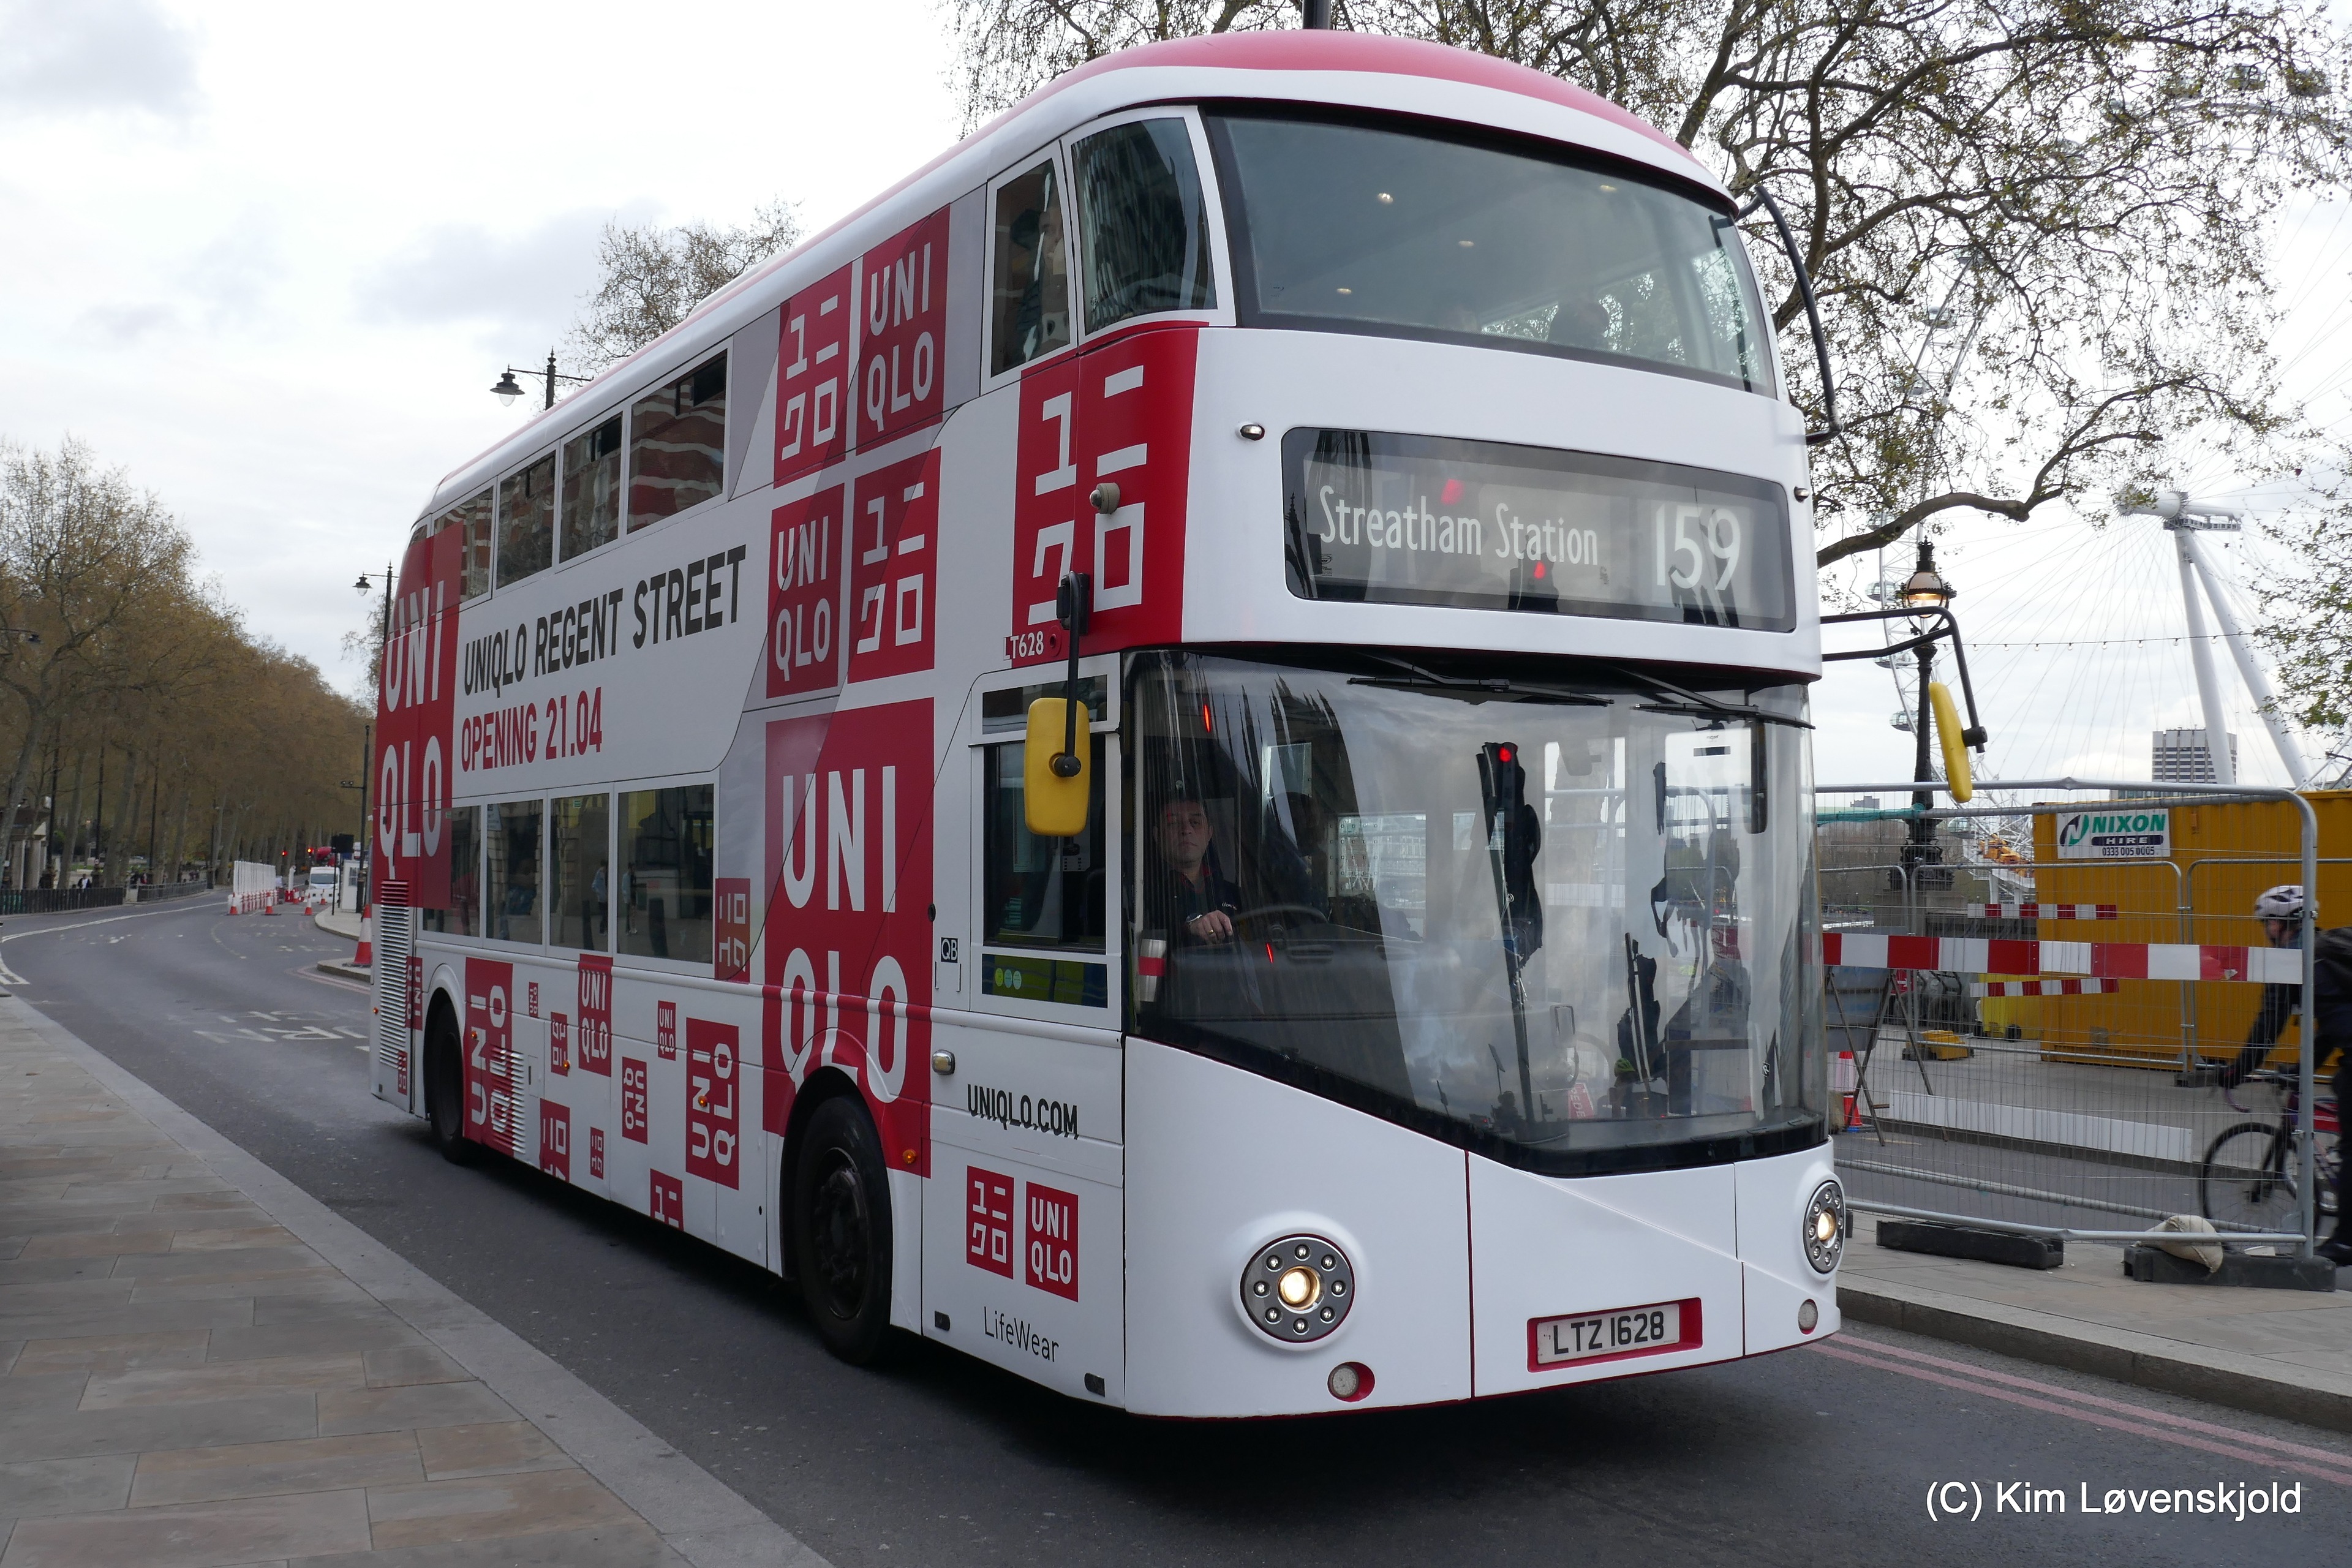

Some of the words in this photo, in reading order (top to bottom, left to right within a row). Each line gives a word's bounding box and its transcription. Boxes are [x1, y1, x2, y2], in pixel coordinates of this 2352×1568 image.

[870, 242, 931, 336] UNI
[867, 331, 934, 433] QLO
[777, 515, 829, 592] UNI
[1319, 484, 1482, 556] Streatham
[1495, 502, 1599, 566] Station
[1656, 502, 1743, 590] 159
[385, 580, 445, 712] UNI
[464, 623, 527, 698] UNIQLO
[533, 587, 624, 677] REGENT
[633, 543, 747, 650] STREET
[775, 598, 831, 682] QLO
[1003, 630, 1044, 662] LT628
[461, 702, 538, 772] OPENING
[545, 686, 603, 760] 21.04
[380, 736, 442, 880] QLO
[782, 766, 895, 913] UNI
[2092, 814, 2166, 833] NIXON
[2102, 847, 2119, 856] 0333
[2120, 847, 2134, 856] 005
[941, 938, 958, 961] QB
[581, 969, 606, 1011] UNI
[660, 1008, 673, 1030] UNI
[780, 947, 908, 1103] QLO
[470, 994, 486, 1126] UNI
[581, 1017, 608, 1064] QLO
[660, 1031, 674, 1055] QLO
[624, 1067, 634, 1130] QLO
[635, 1069, 644, 1128] UNI
[692, 1049, 710, 1159] UNI
[714, 1042, 735, 1166] QLO
[967, 1083, 1079, 1140] UNIQLO.COM
[1031, 1196, 1068, 1242] UNI
[1031, 1240, 1072, 1284] QLO
[984, 1306, 1060, 1363] LifeWear
[1553, 1319, 1603, 1355] LTZ
[1610, 1311, 1664, 1346] 1628
